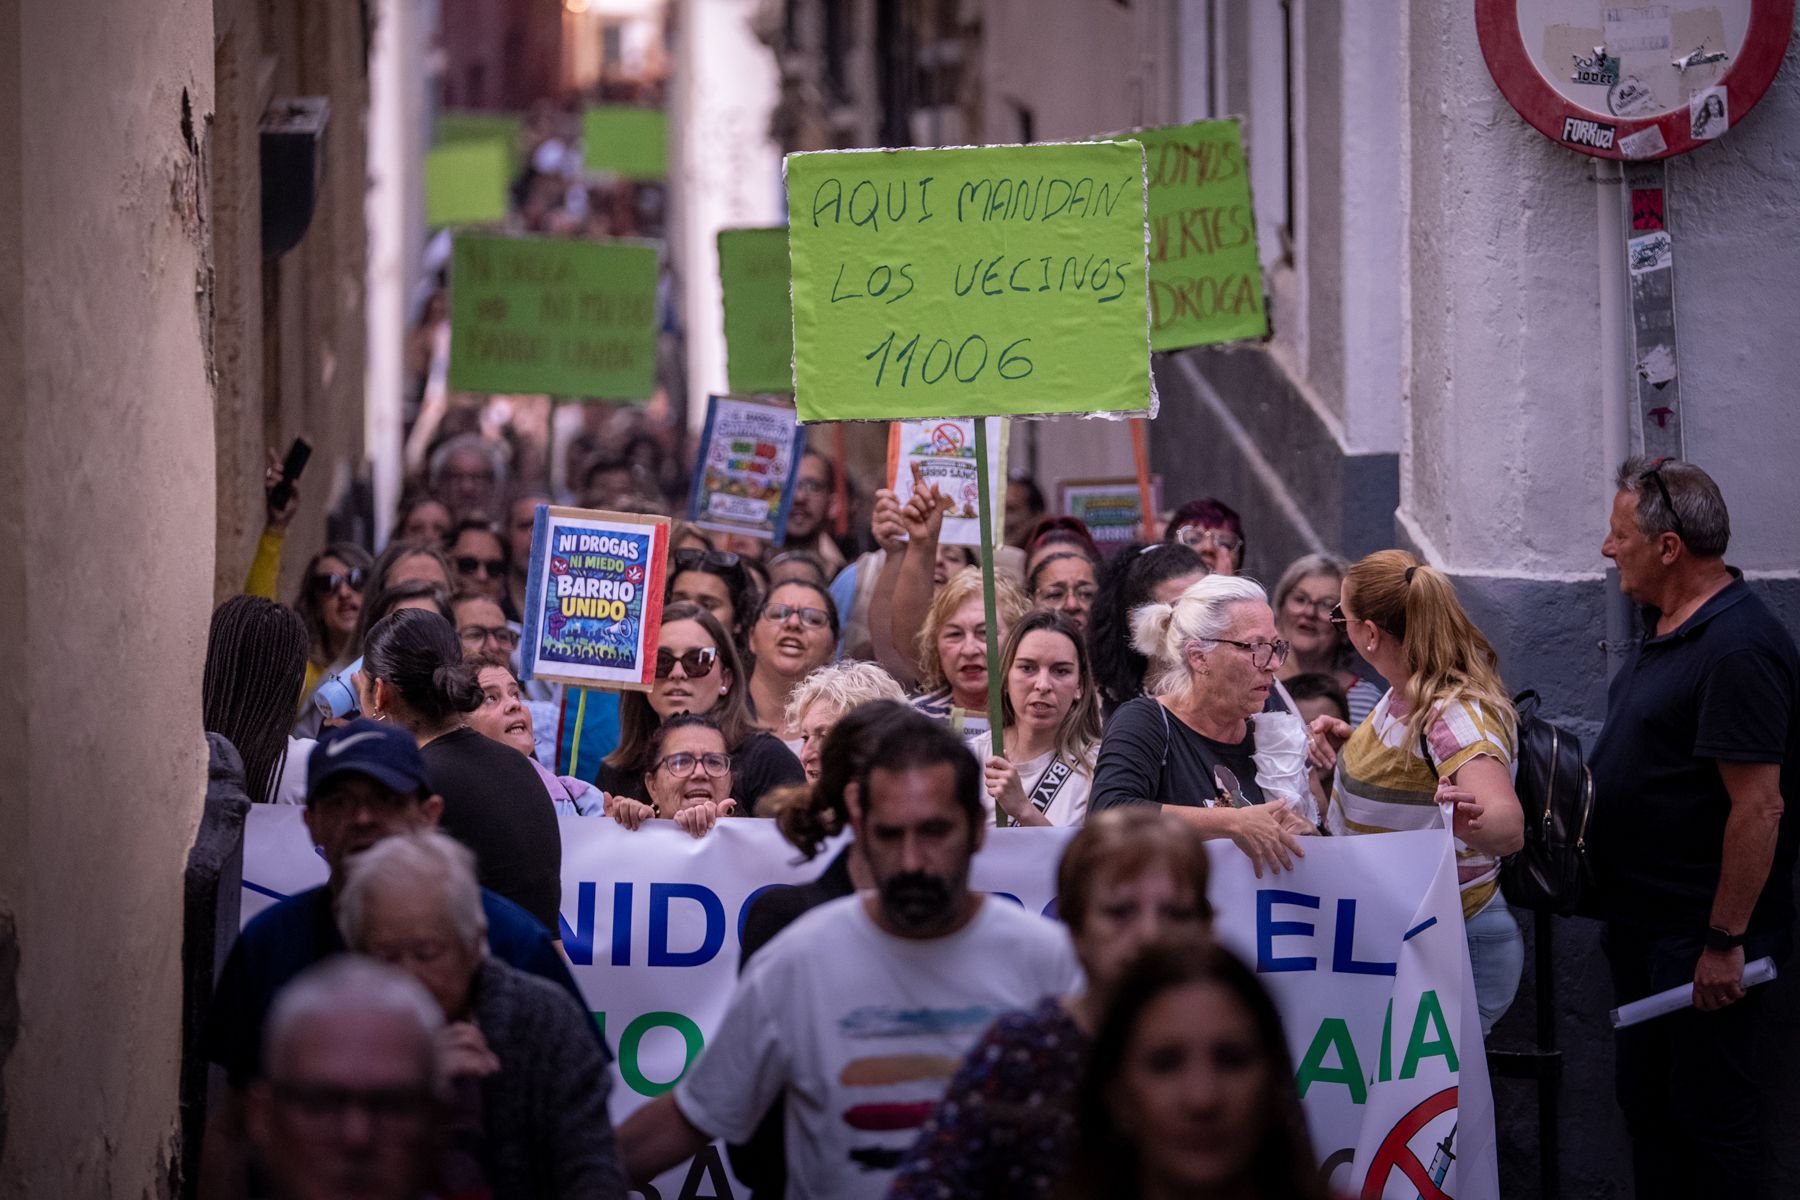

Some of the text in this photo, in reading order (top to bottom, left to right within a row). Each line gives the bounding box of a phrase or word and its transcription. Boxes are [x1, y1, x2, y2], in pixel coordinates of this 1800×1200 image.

[812, 175, 1134, 232] AQUI MANDAN
[830, 263, 916, 305] LOS
[1150, 272, 1258, 332] DROGA
[865, 331, 1034, 388] 11006
[559, 534, 640, 560] NI DROGAS
[569, 555, 625, 573] NI MIEDO
[557, 574, 635, 601] BARRIO
[561, 599, 626, 621] UNIDO
[1256, 888, 1397, 976] EL
